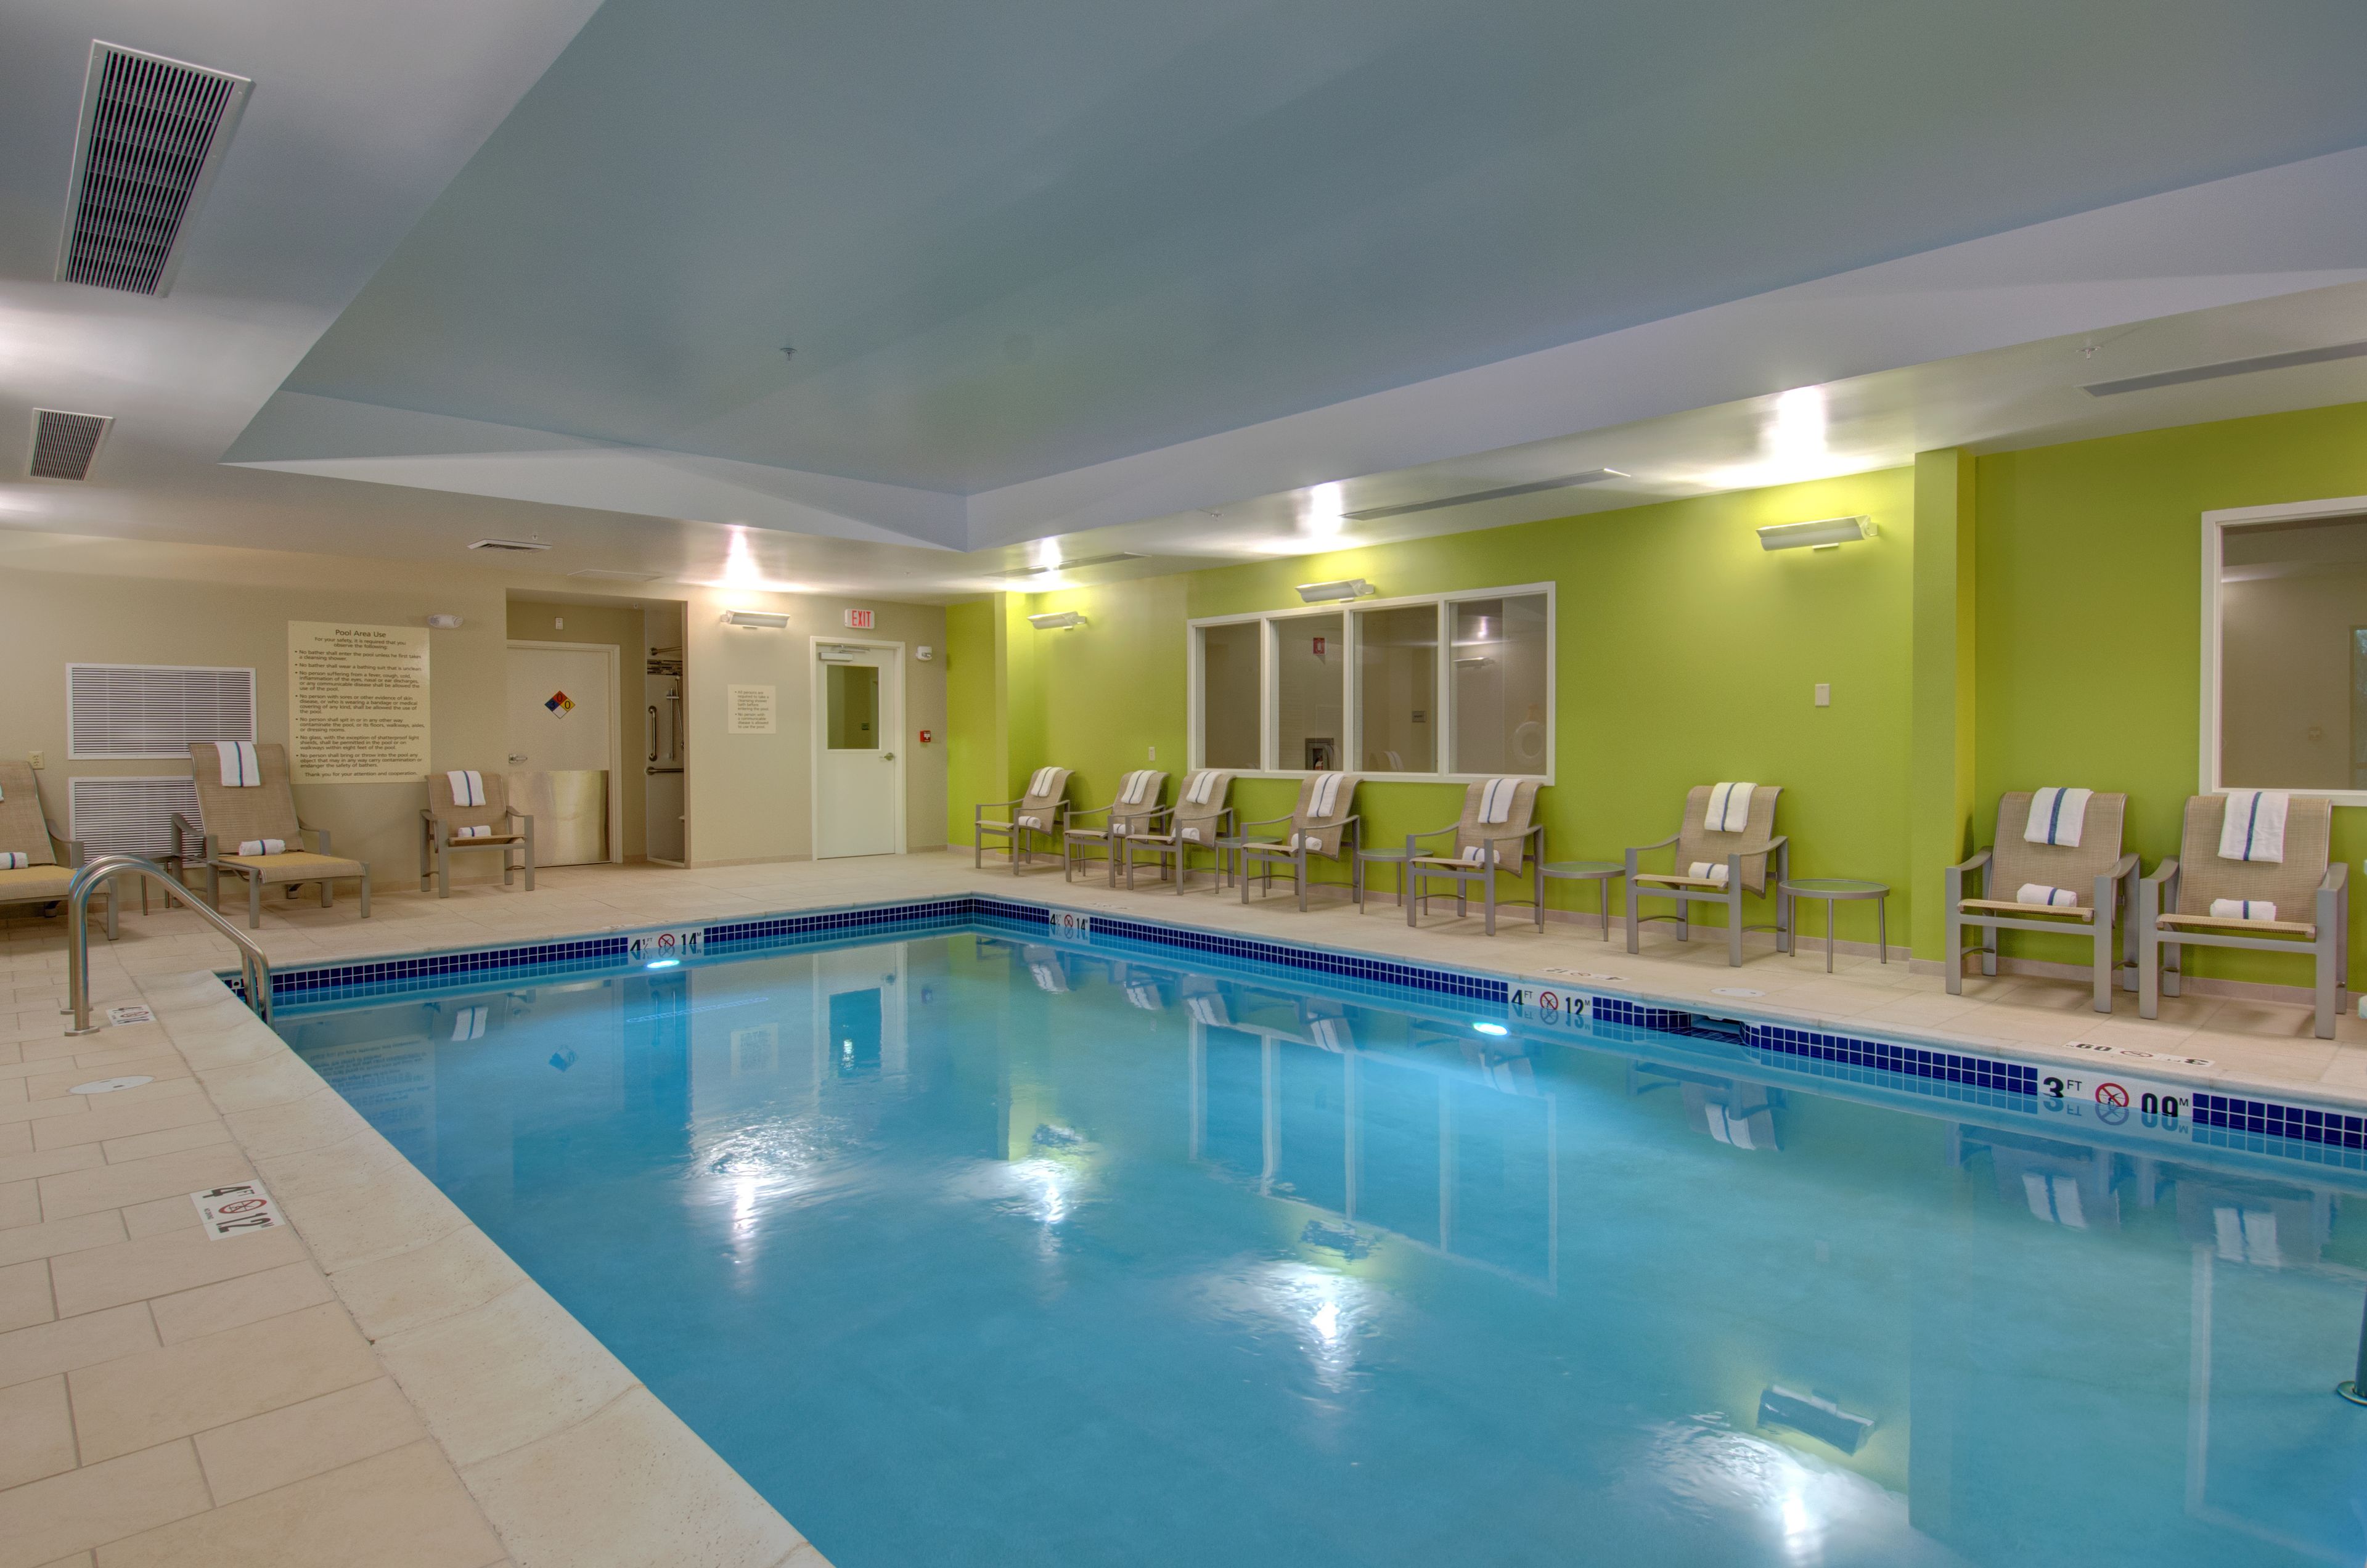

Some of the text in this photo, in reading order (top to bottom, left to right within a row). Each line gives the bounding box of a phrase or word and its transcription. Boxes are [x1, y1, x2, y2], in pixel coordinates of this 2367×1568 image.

[852, 610, 871, 627] EXIT
[557, 694, 563, 702] 0
[565, 701, 571, 709] 0
[1050, 913, 1056, 925] 4
[630, 939, 640, 951] 4
[1511, 990, 1524, 1005] 4
[1524, 990, 1533, 999] FT
[2043, 1077, 2064, 1098] 3
[2067, 1080, 2082, 1091] FT
[2180, 1098, 2189, 1107] M
[202, 1186, 252, 1199] 4
